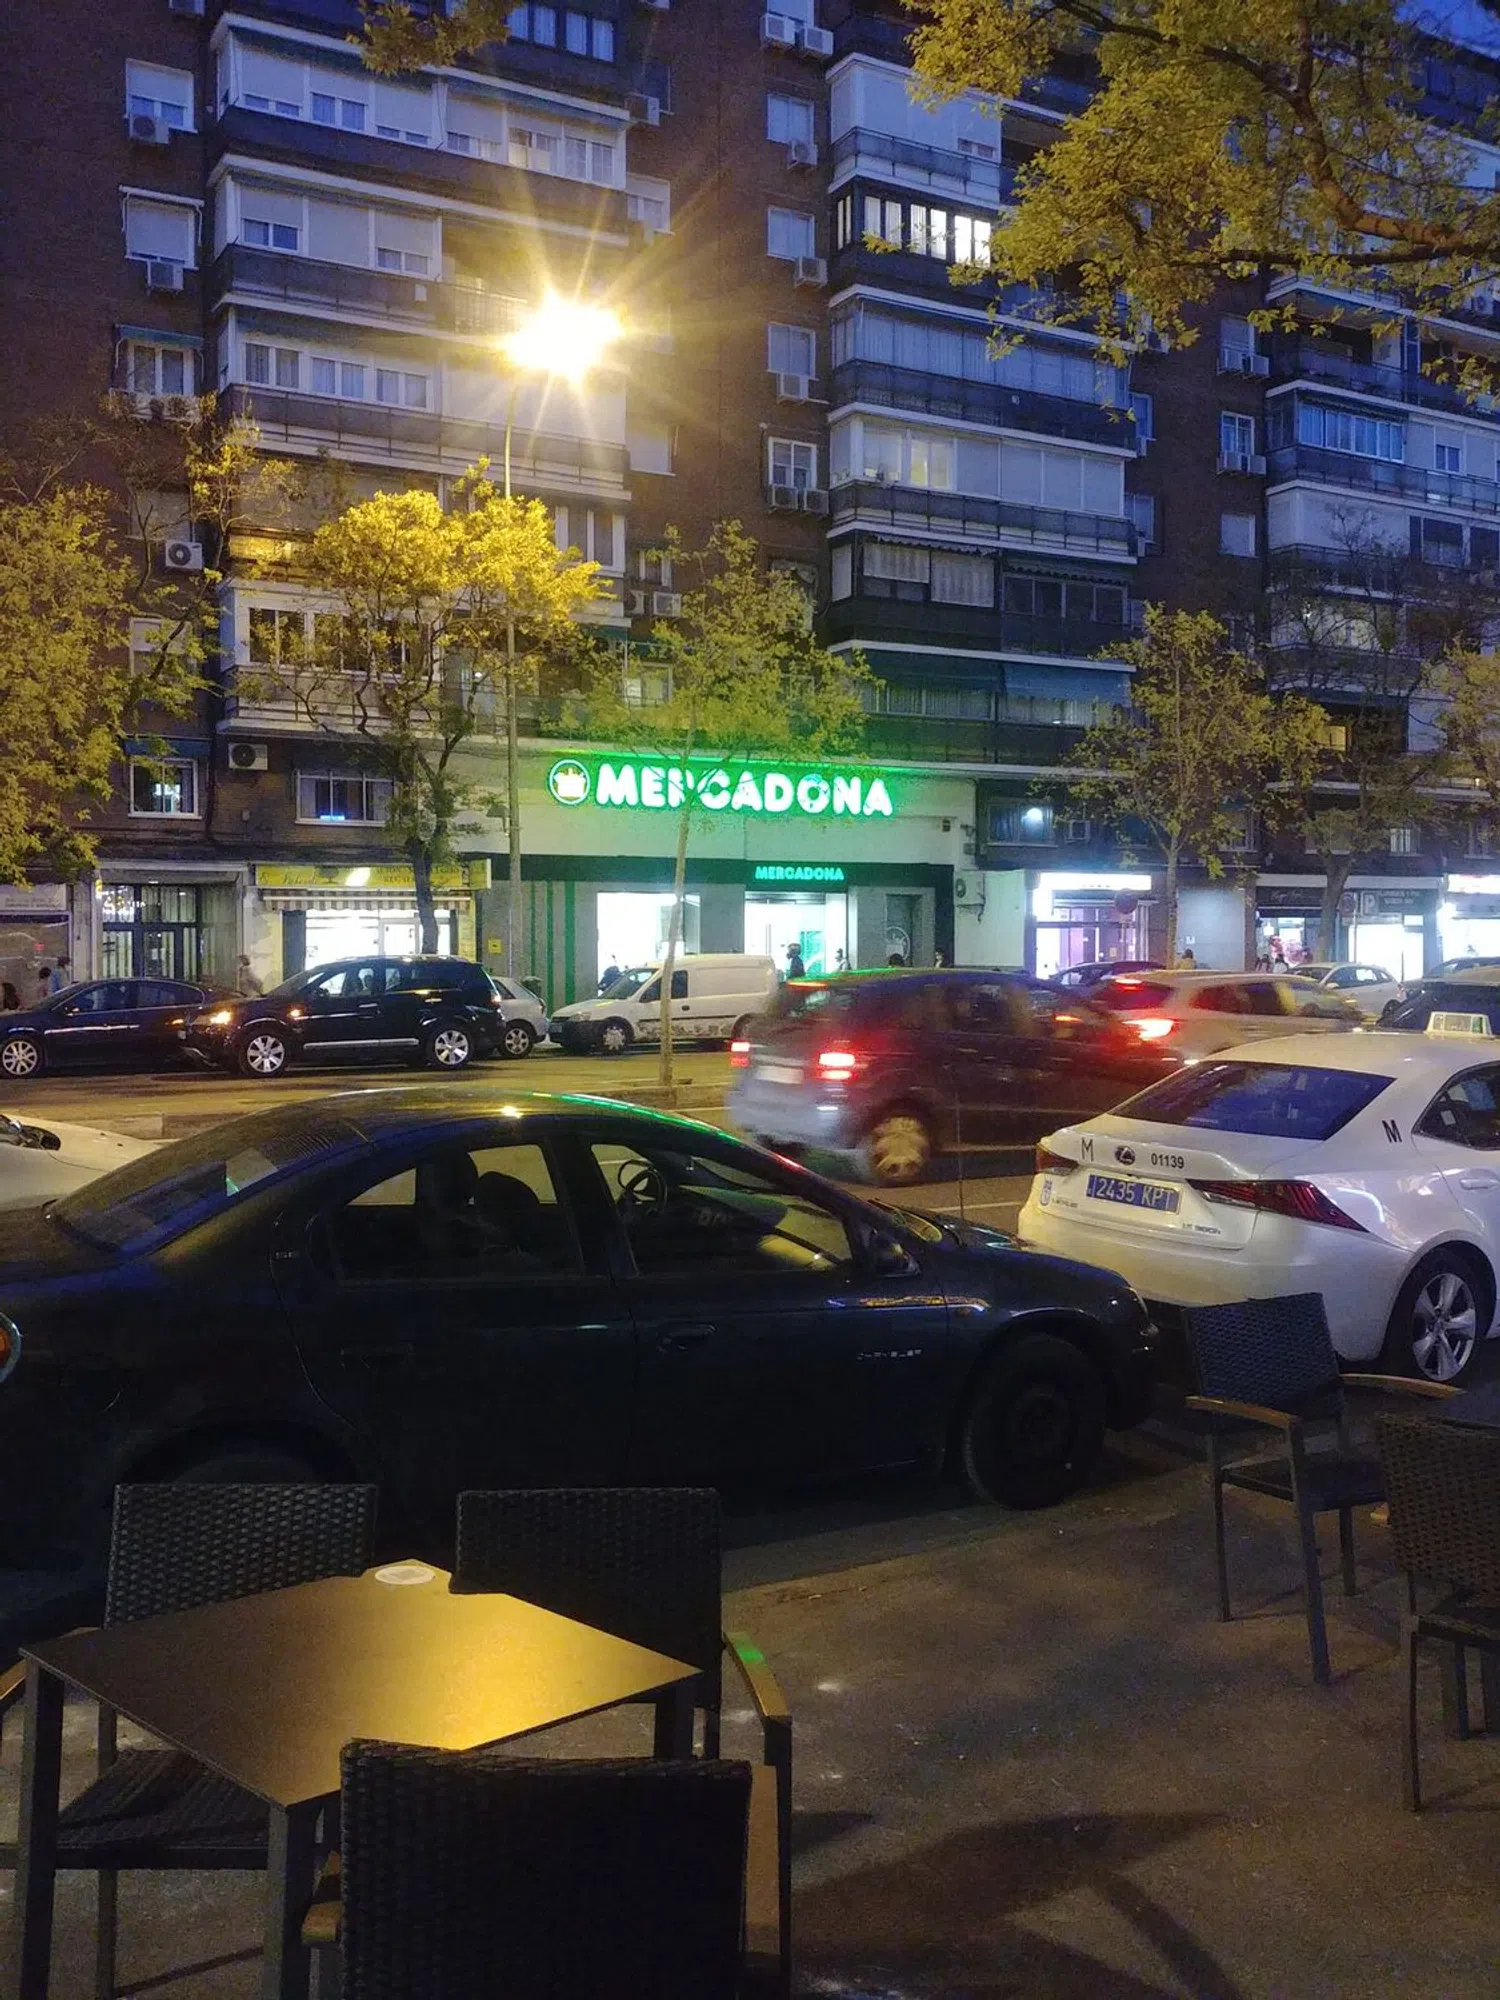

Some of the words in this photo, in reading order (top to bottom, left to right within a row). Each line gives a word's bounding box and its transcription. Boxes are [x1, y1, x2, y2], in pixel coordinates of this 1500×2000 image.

[595, 763, 893, 816] MERCADONA
[755, 866, 844, 881] MERCADONA
[1381, 1119, 1403, 1143] M
[1081, 1137, 1094, 1162] M
[1150, 1153, 1185, 1169] 01139
[1096, 1178, 1135, 1202] 2435
[1141, 1184, 1175, 1210] KPT
